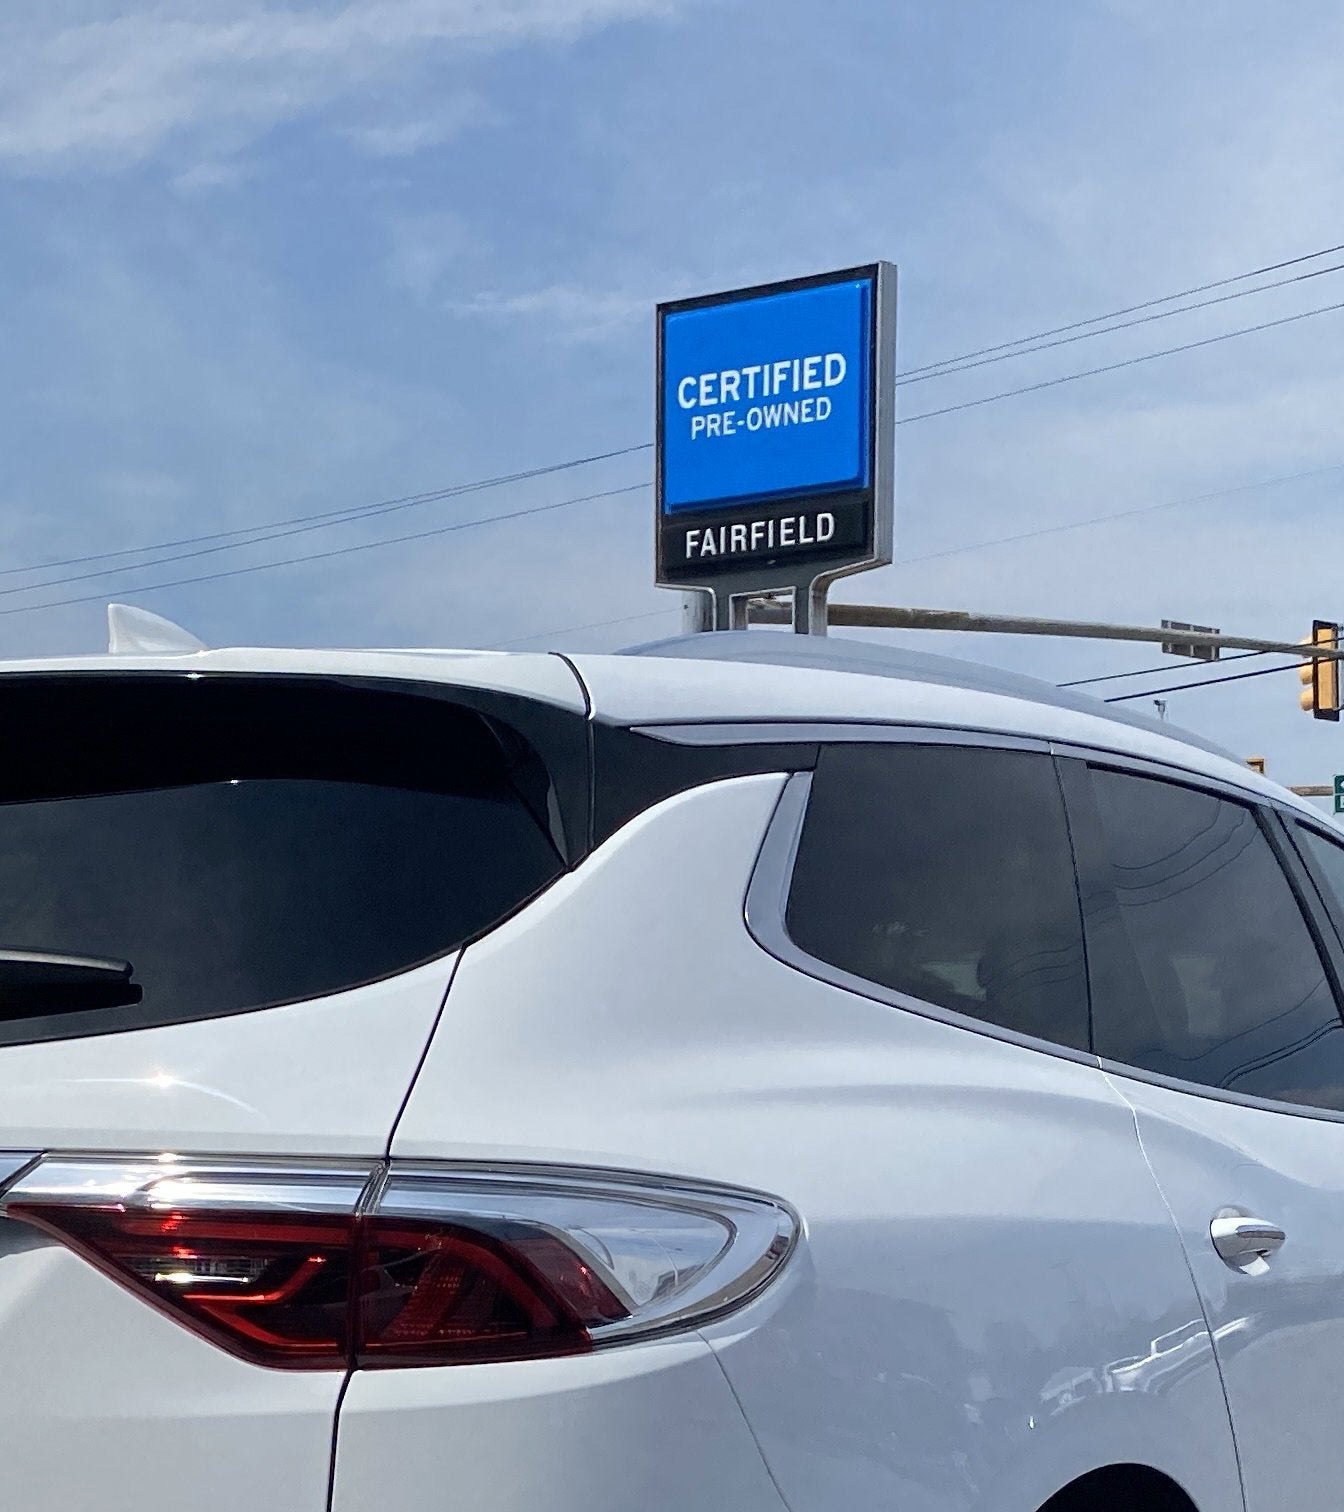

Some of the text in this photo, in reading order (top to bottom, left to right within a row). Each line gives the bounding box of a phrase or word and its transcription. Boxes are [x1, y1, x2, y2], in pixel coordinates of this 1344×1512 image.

[677, 352, 848, 409] CERTIFIED
[691, 396, 832, 440] PRE-OWNED
[685, 512, 835, 559] FAIRFIELD
